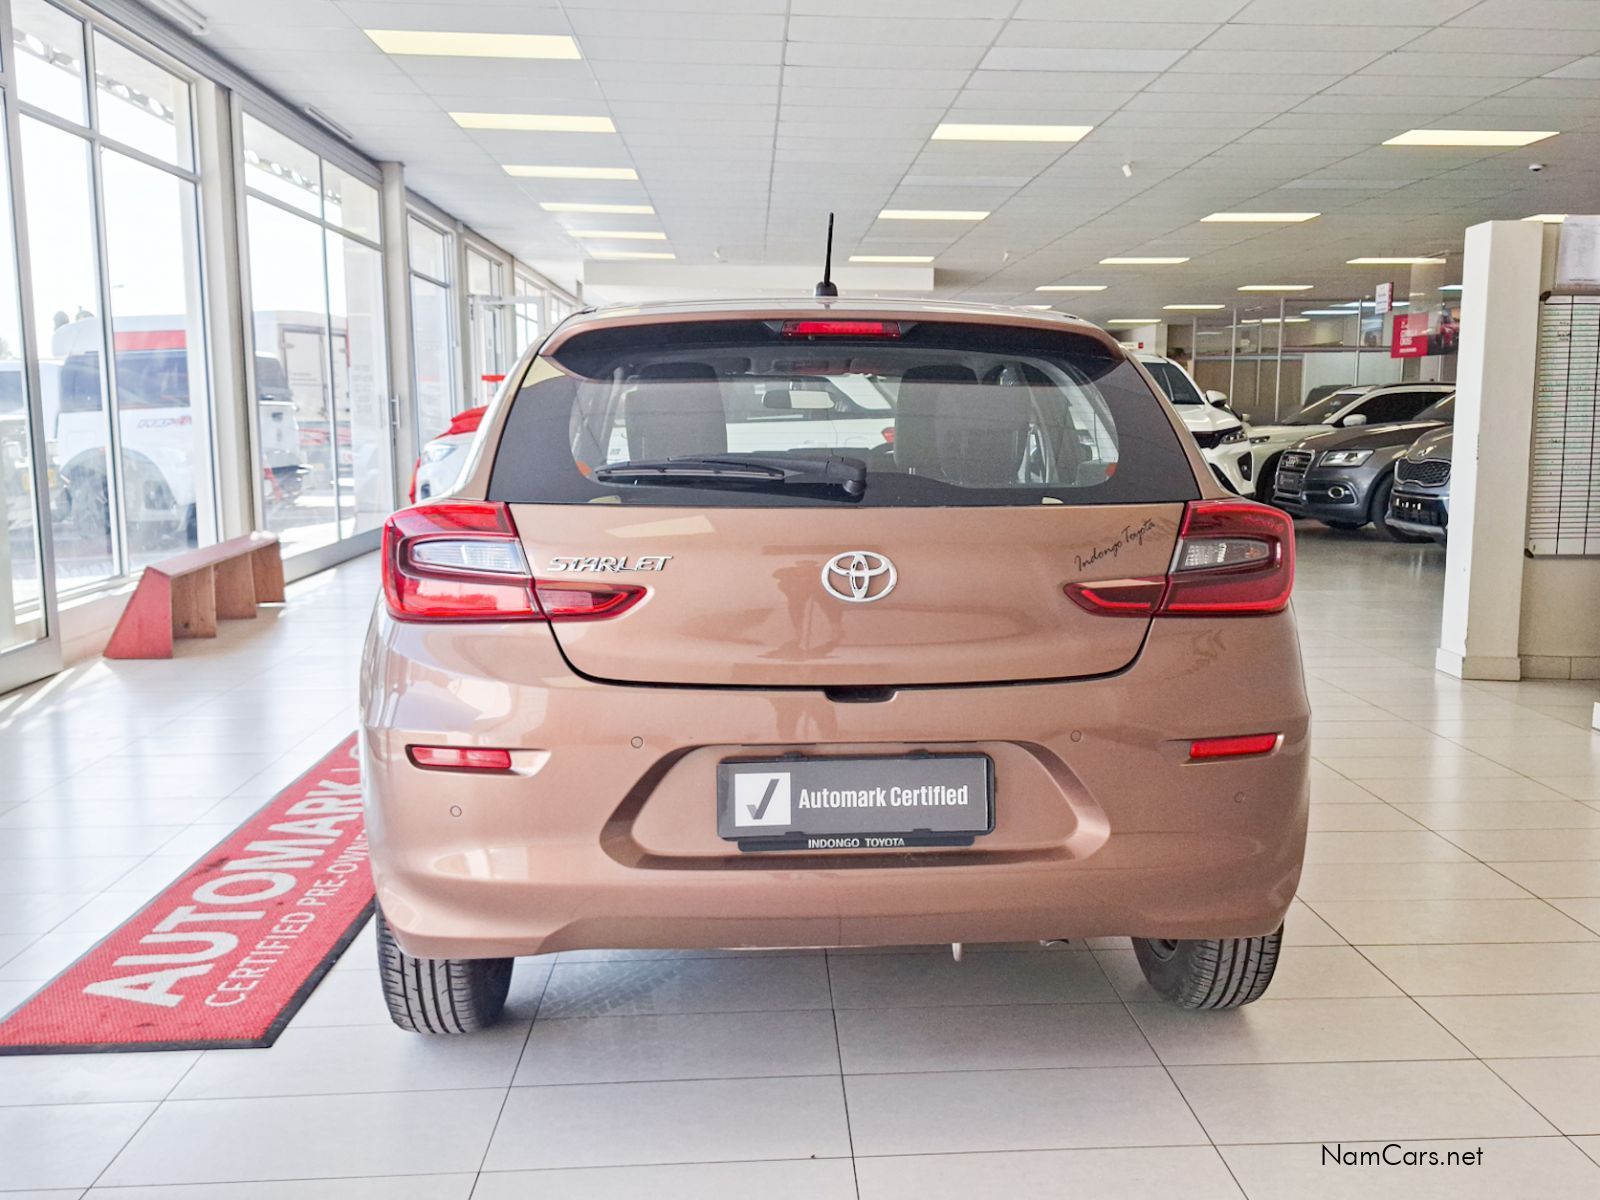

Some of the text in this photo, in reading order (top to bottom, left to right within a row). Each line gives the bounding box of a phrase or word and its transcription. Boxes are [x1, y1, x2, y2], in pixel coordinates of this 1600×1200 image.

[546, 555, 674, 573] STARLET
[1074, 517, 1156, 572] Indongo Toyota
[798, 786, 968, 809] Automark Certified
[807, 837, 906, 849] INDONGO TOYOTA
[83, 779, 363, 1008] AUTOMARK
[204, 911, 316, 1008] CERTIFIED
